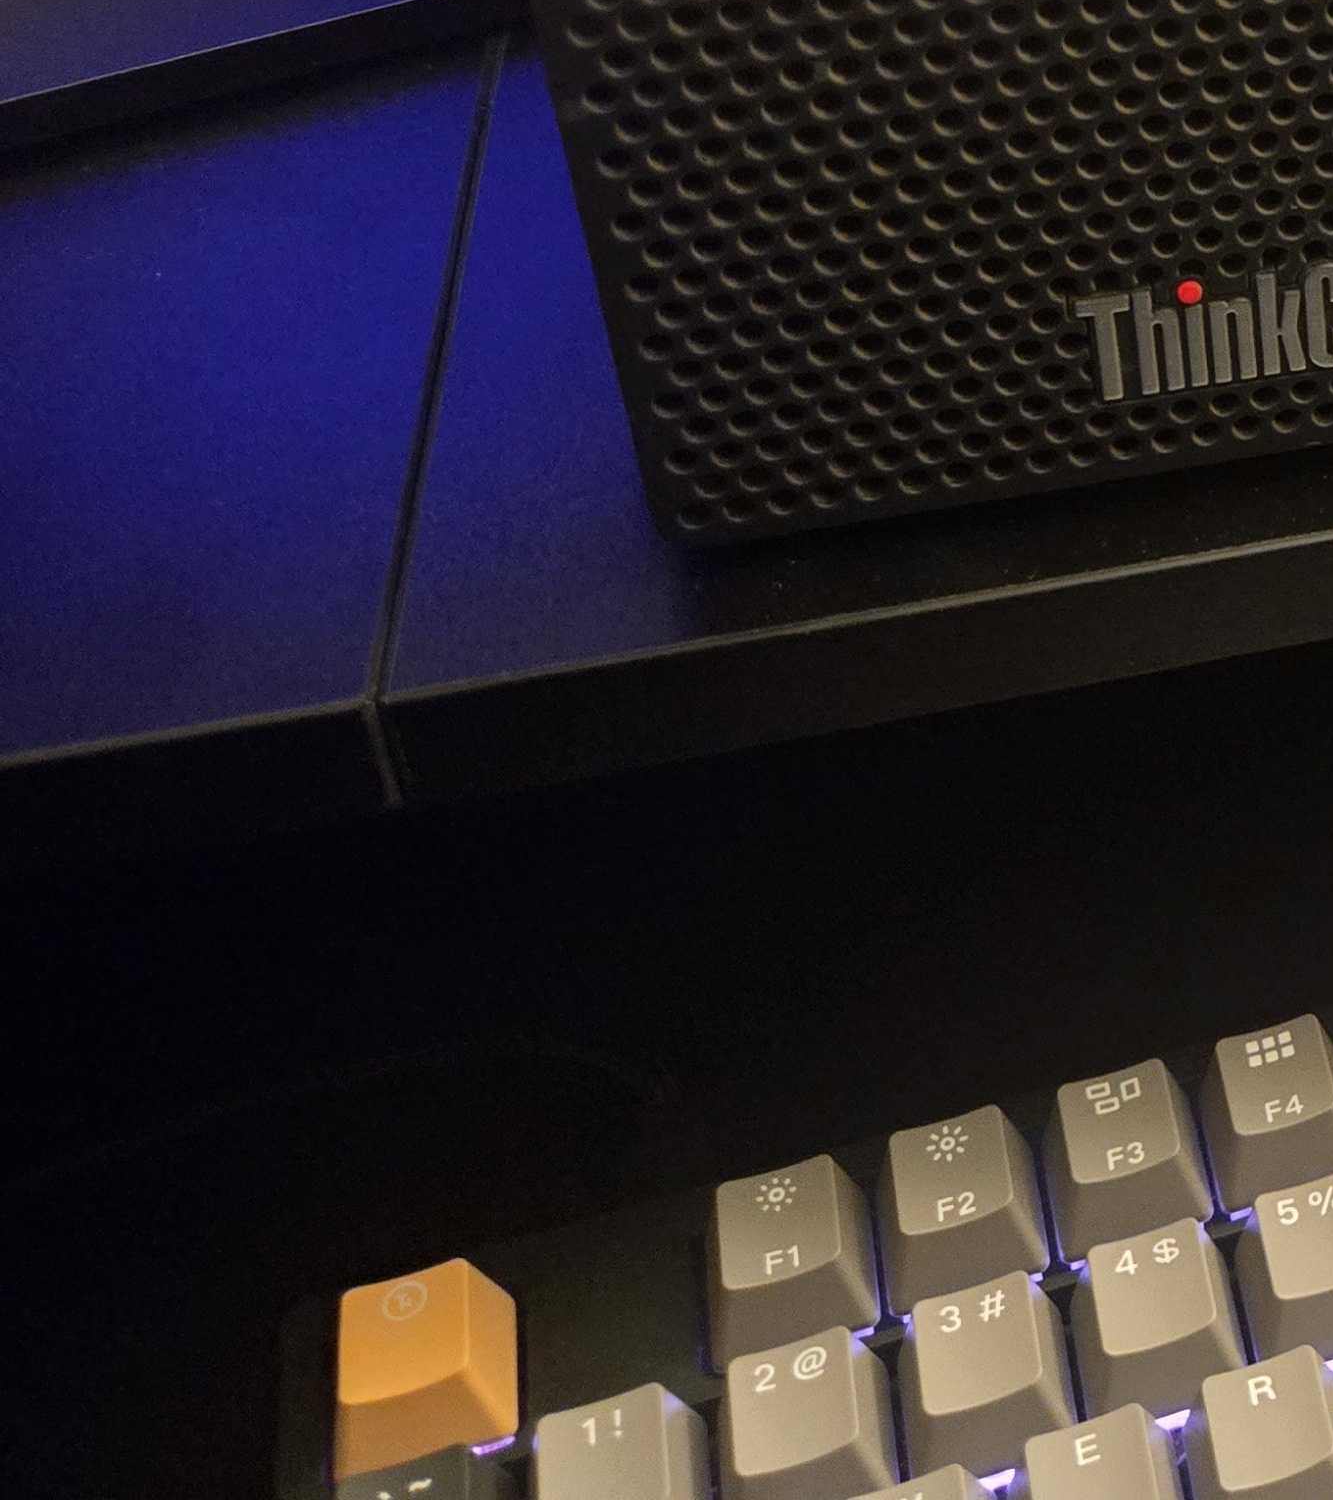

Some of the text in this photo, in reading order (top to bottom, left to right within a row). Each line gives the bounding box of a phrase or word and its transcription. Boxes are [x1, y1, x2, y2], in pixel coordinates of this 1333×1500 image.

[1264, 1094, 1304, 1122] F4
[1106, 1142, 1145, 1170] F3
[937, 1192, 976, 1222] F2
[1278, 1199, 1298, 1225] 5
[764, 1246, 800, 1275] F1
[1114, 1250, 1138, 1274] 4
[940, 1306, 962, 1332] 3
[754, 1364, 776, 1392] 2
[1248, 1375, 1276, 1406] R
[582, 1418, 596, 1445] 1
[1074, 1434, 1100, 1466] E
